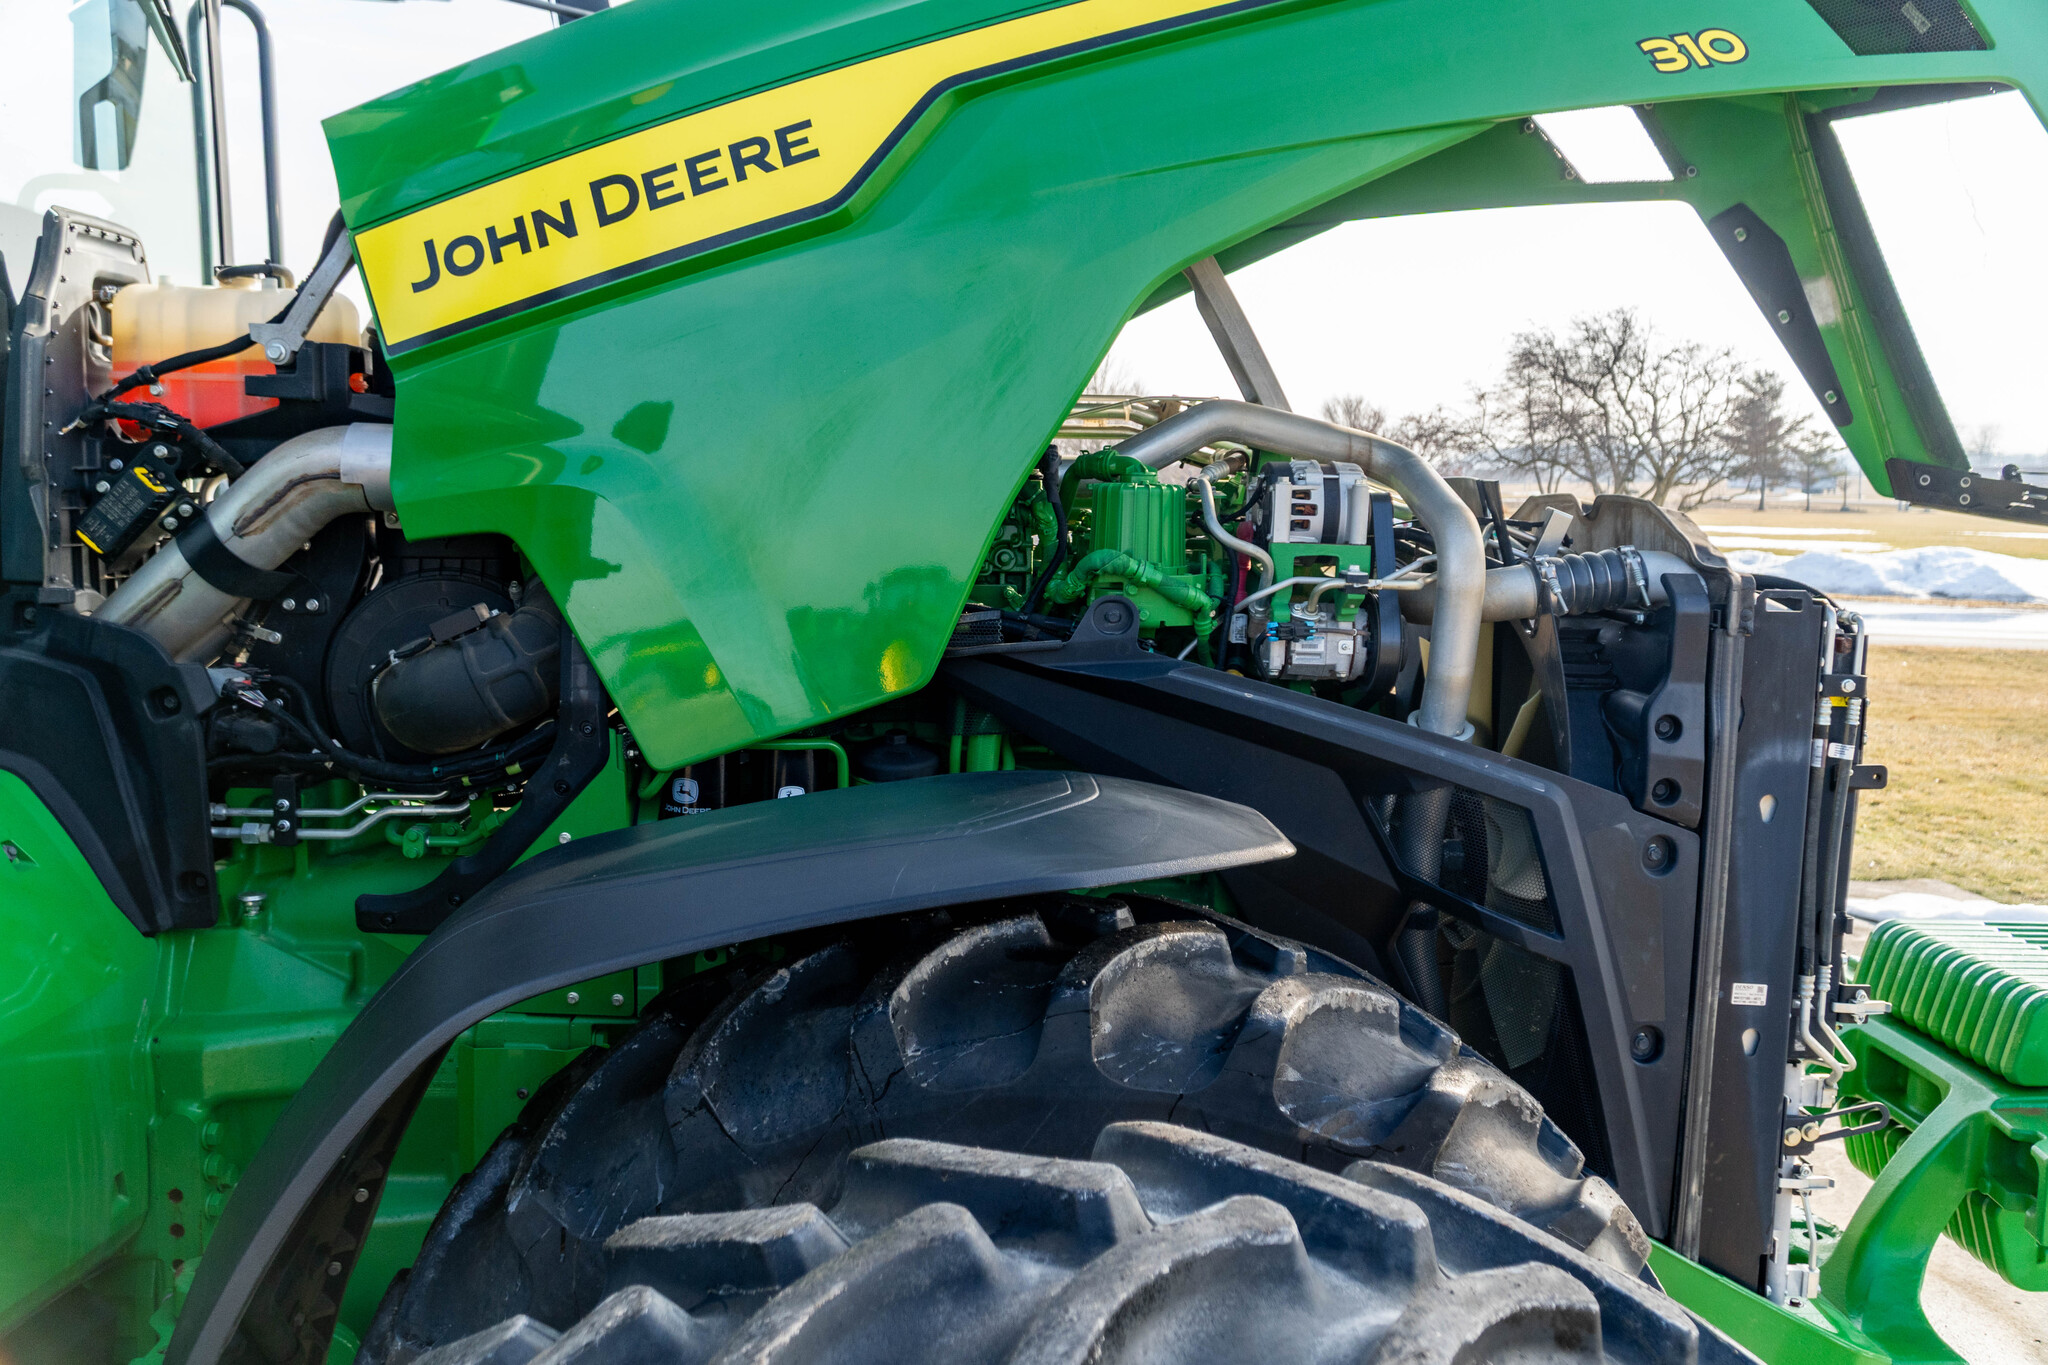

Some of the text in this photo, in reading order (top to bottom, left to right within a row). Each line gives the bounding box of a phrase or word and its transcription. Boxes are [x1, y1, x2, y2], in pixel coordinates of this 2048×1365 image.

[1636, 28, 1750, 74] 310
[411, 118, 821, 294] JOHN DEERE
[665, 803, 681, 813] JOHN
